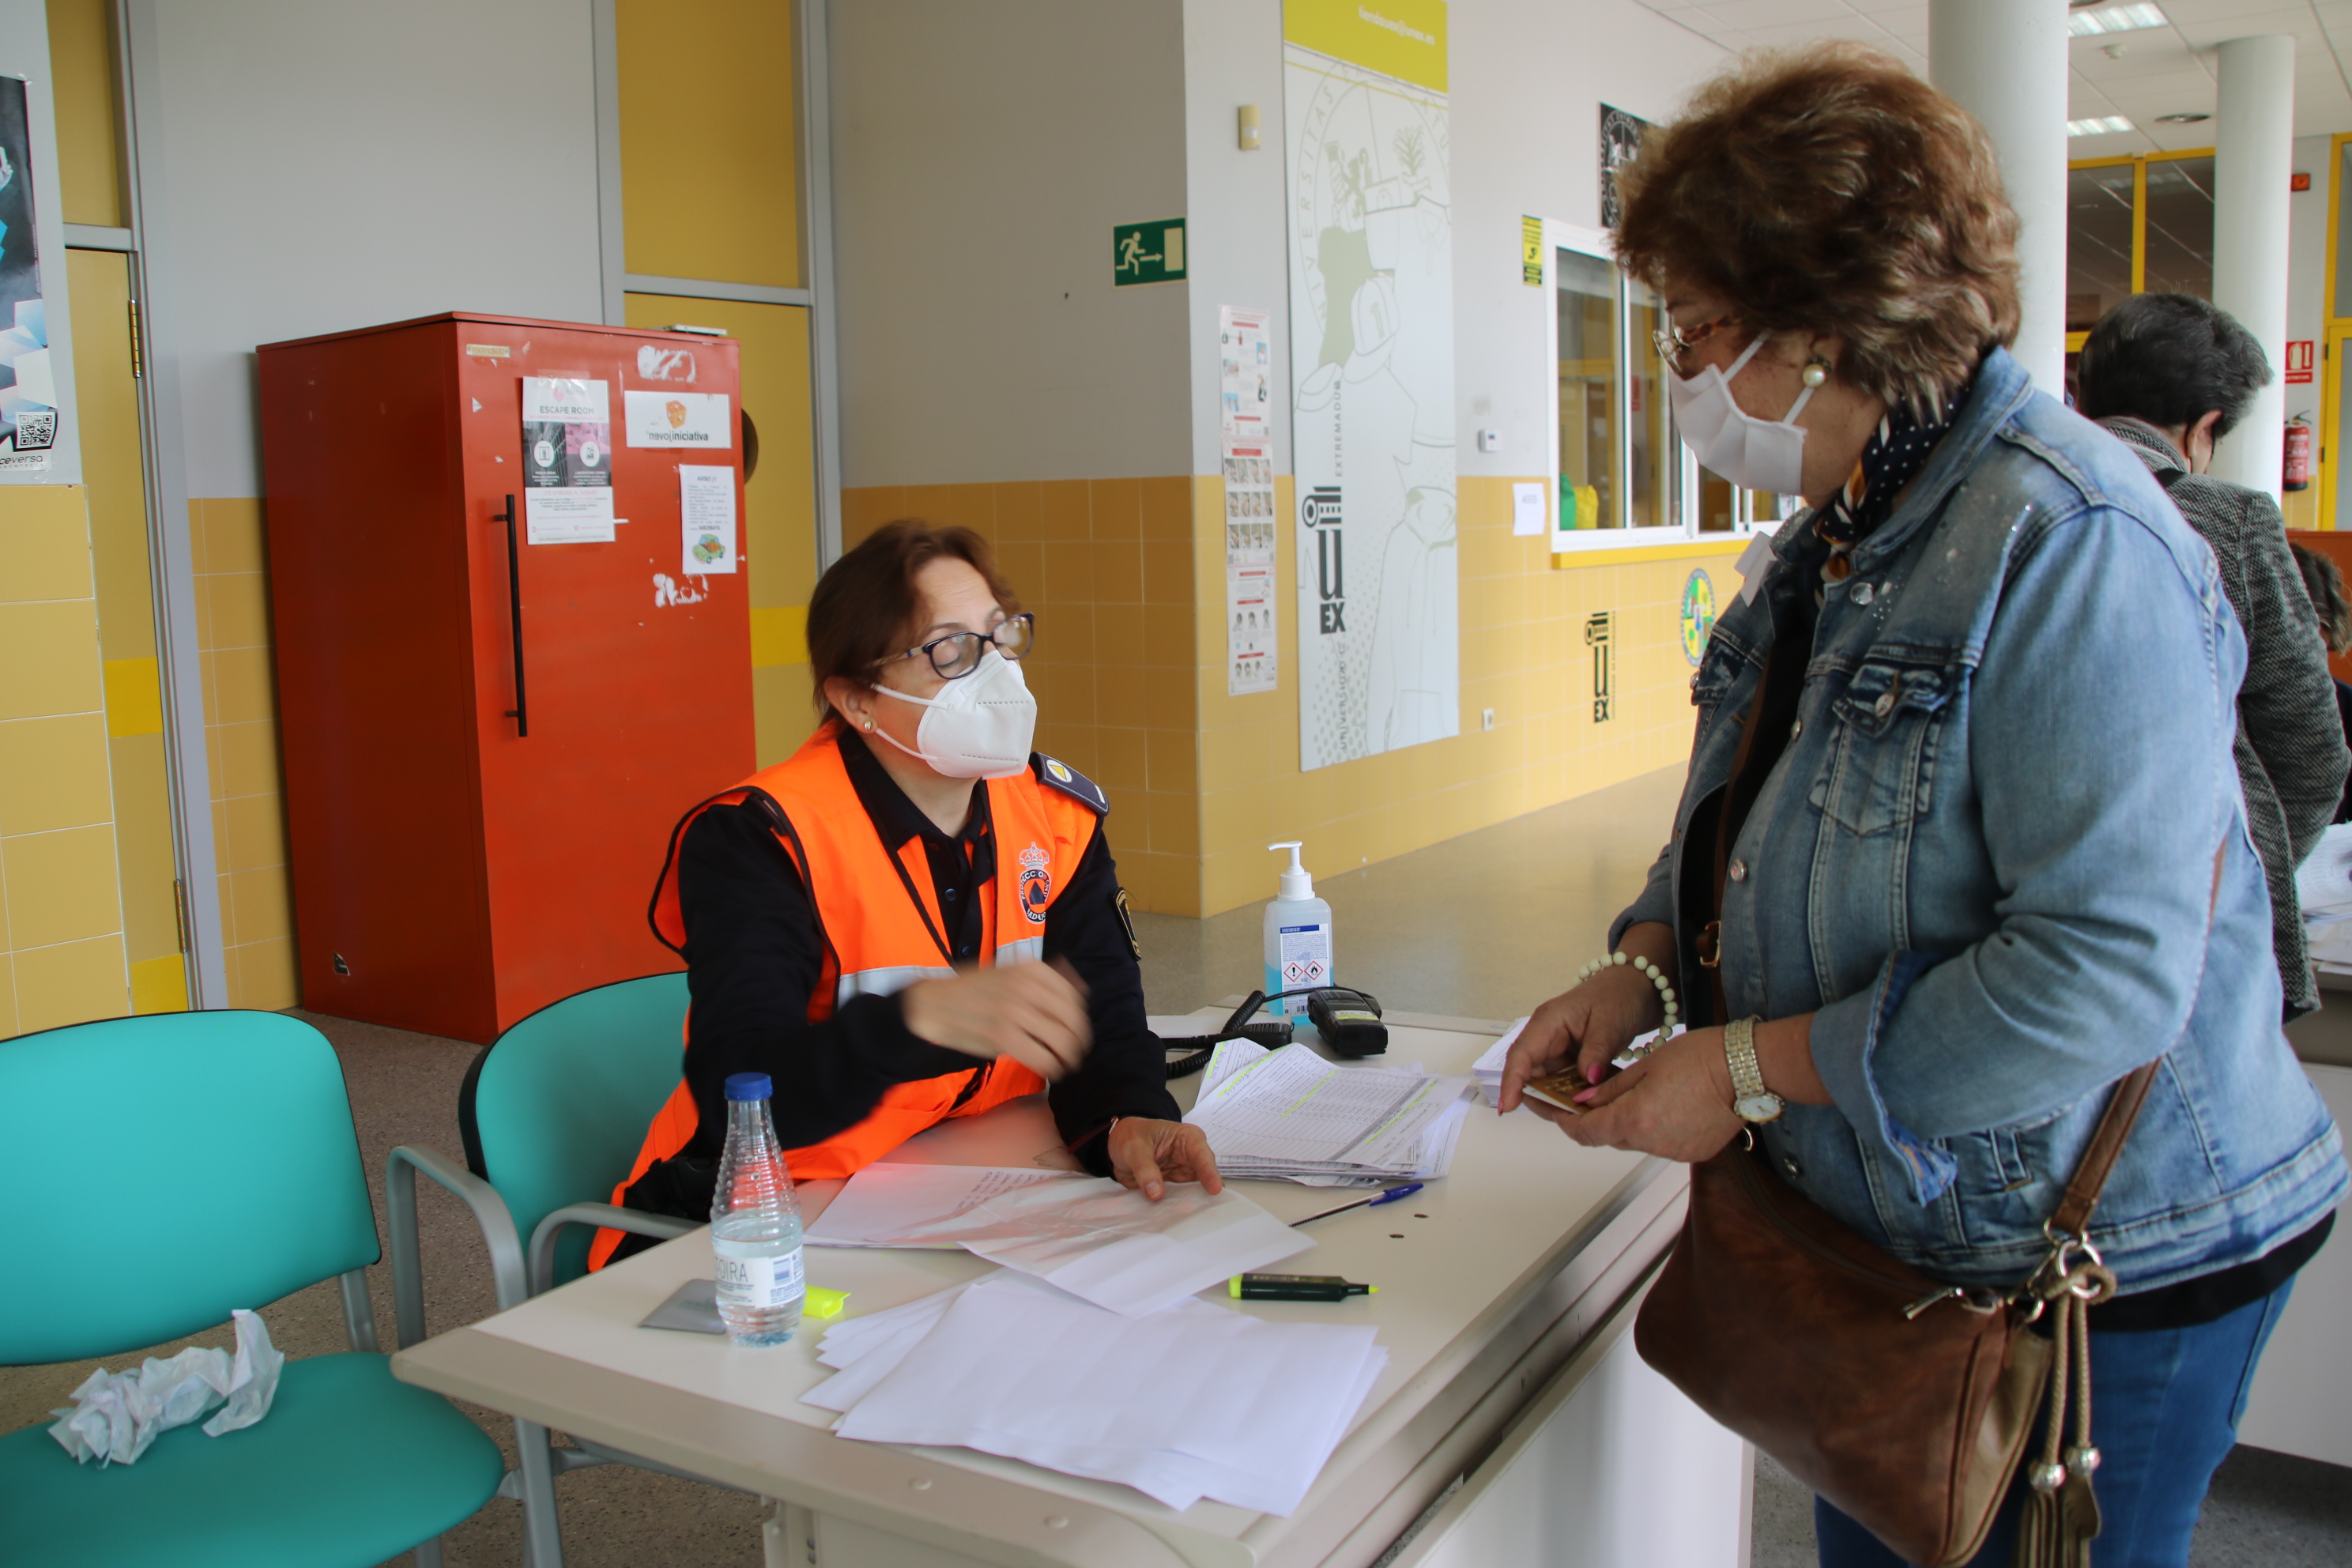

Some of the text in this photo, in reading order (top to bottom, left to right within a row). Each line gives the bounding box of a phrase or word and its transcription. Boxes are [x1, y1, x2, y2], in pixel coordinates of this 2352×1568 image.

[539, 405, 594, 415] ESCAPE ROOM
[1320, 601, 1346, 635] EX
[1593, 698, 1609, 723] EX
